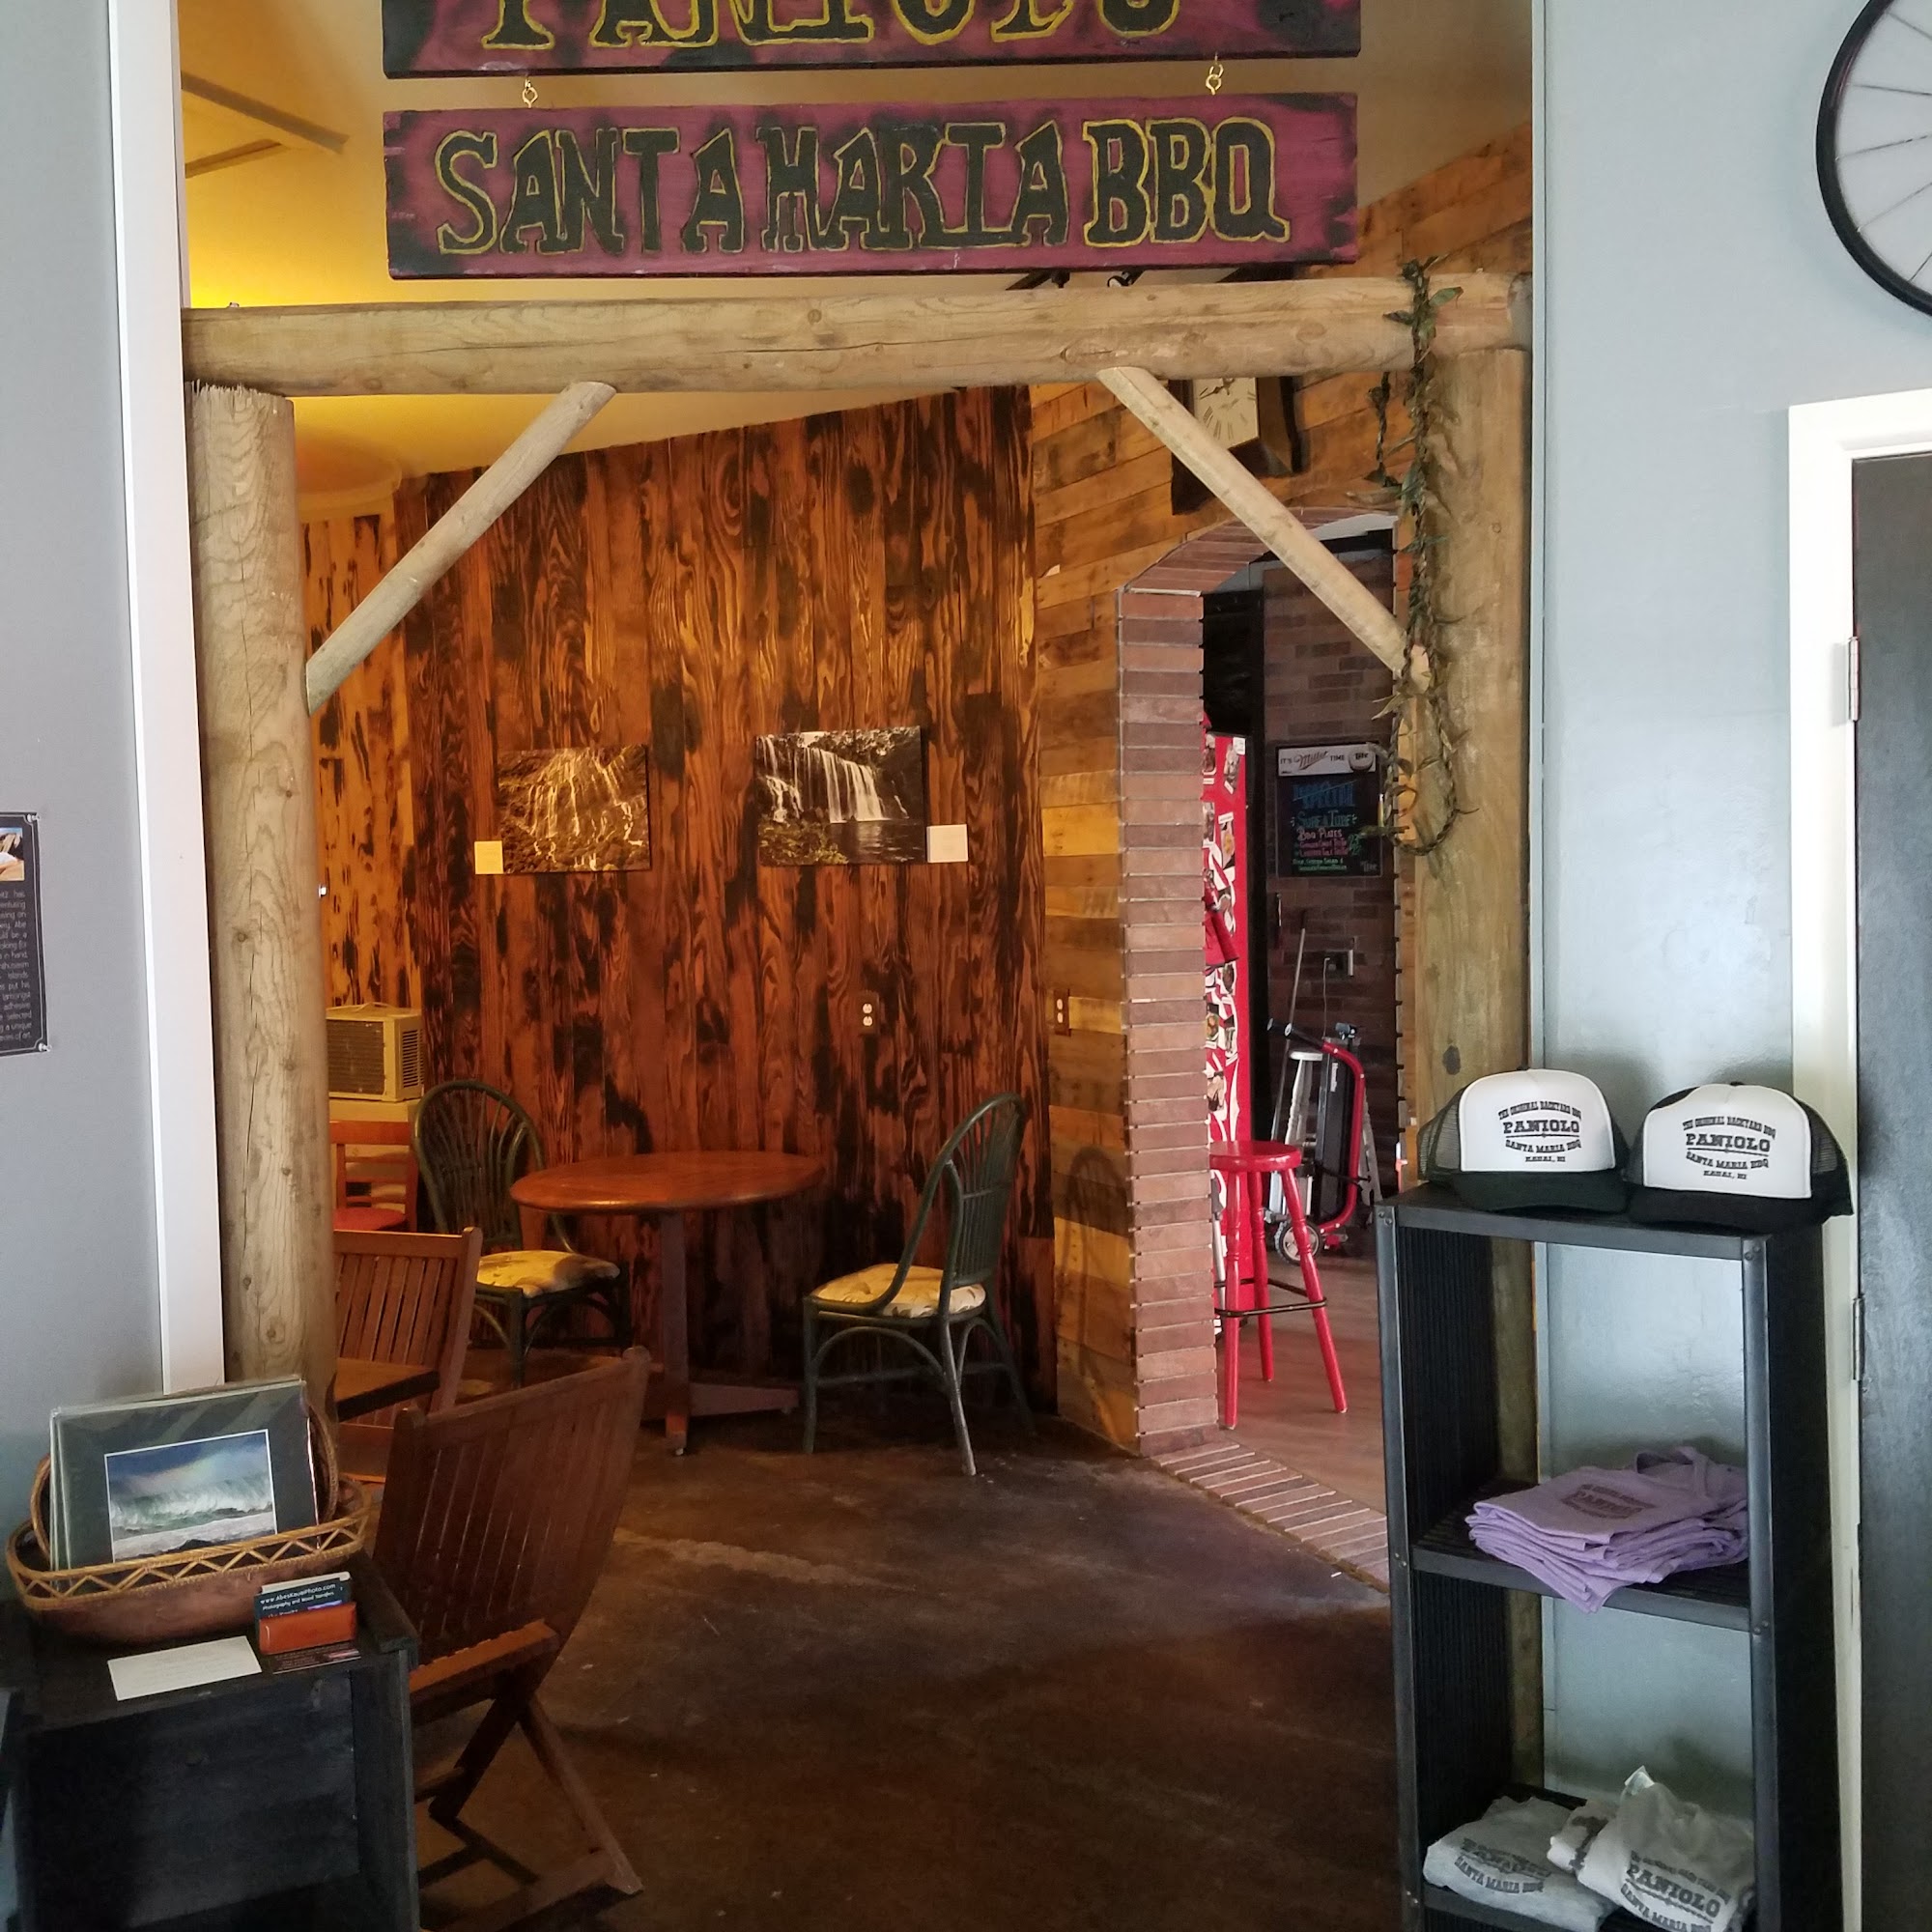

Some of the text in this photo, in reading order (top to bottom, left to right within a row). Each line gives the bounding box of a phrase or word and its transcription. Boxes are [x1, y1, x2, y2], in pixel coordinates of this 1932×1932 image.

[435, 116, 1291, 254] SANTA MARIA BBQ
[1503, 1120, 1579, 1134] PANIOLO
[1505, 1139, 1534, 1152] SANTA
[1536, 1144, 1566, 1153] MARIA
[1686, 1133, 1771, 1152] PANIOLO
[1686, 1151, 1714, 1167] SANTA
[1716, 1159, 1748, 1170] MARIA
[1454, 1855, 1485, 1887] SANTA
[1486, 1877, 1520, 1894] MARIA
[1627, 1863, 1721, 1918] PANIOLO
[1621, 1884, 1650, 1918] SANTA
[1652, 1912, 1688, 1932] MARIA
